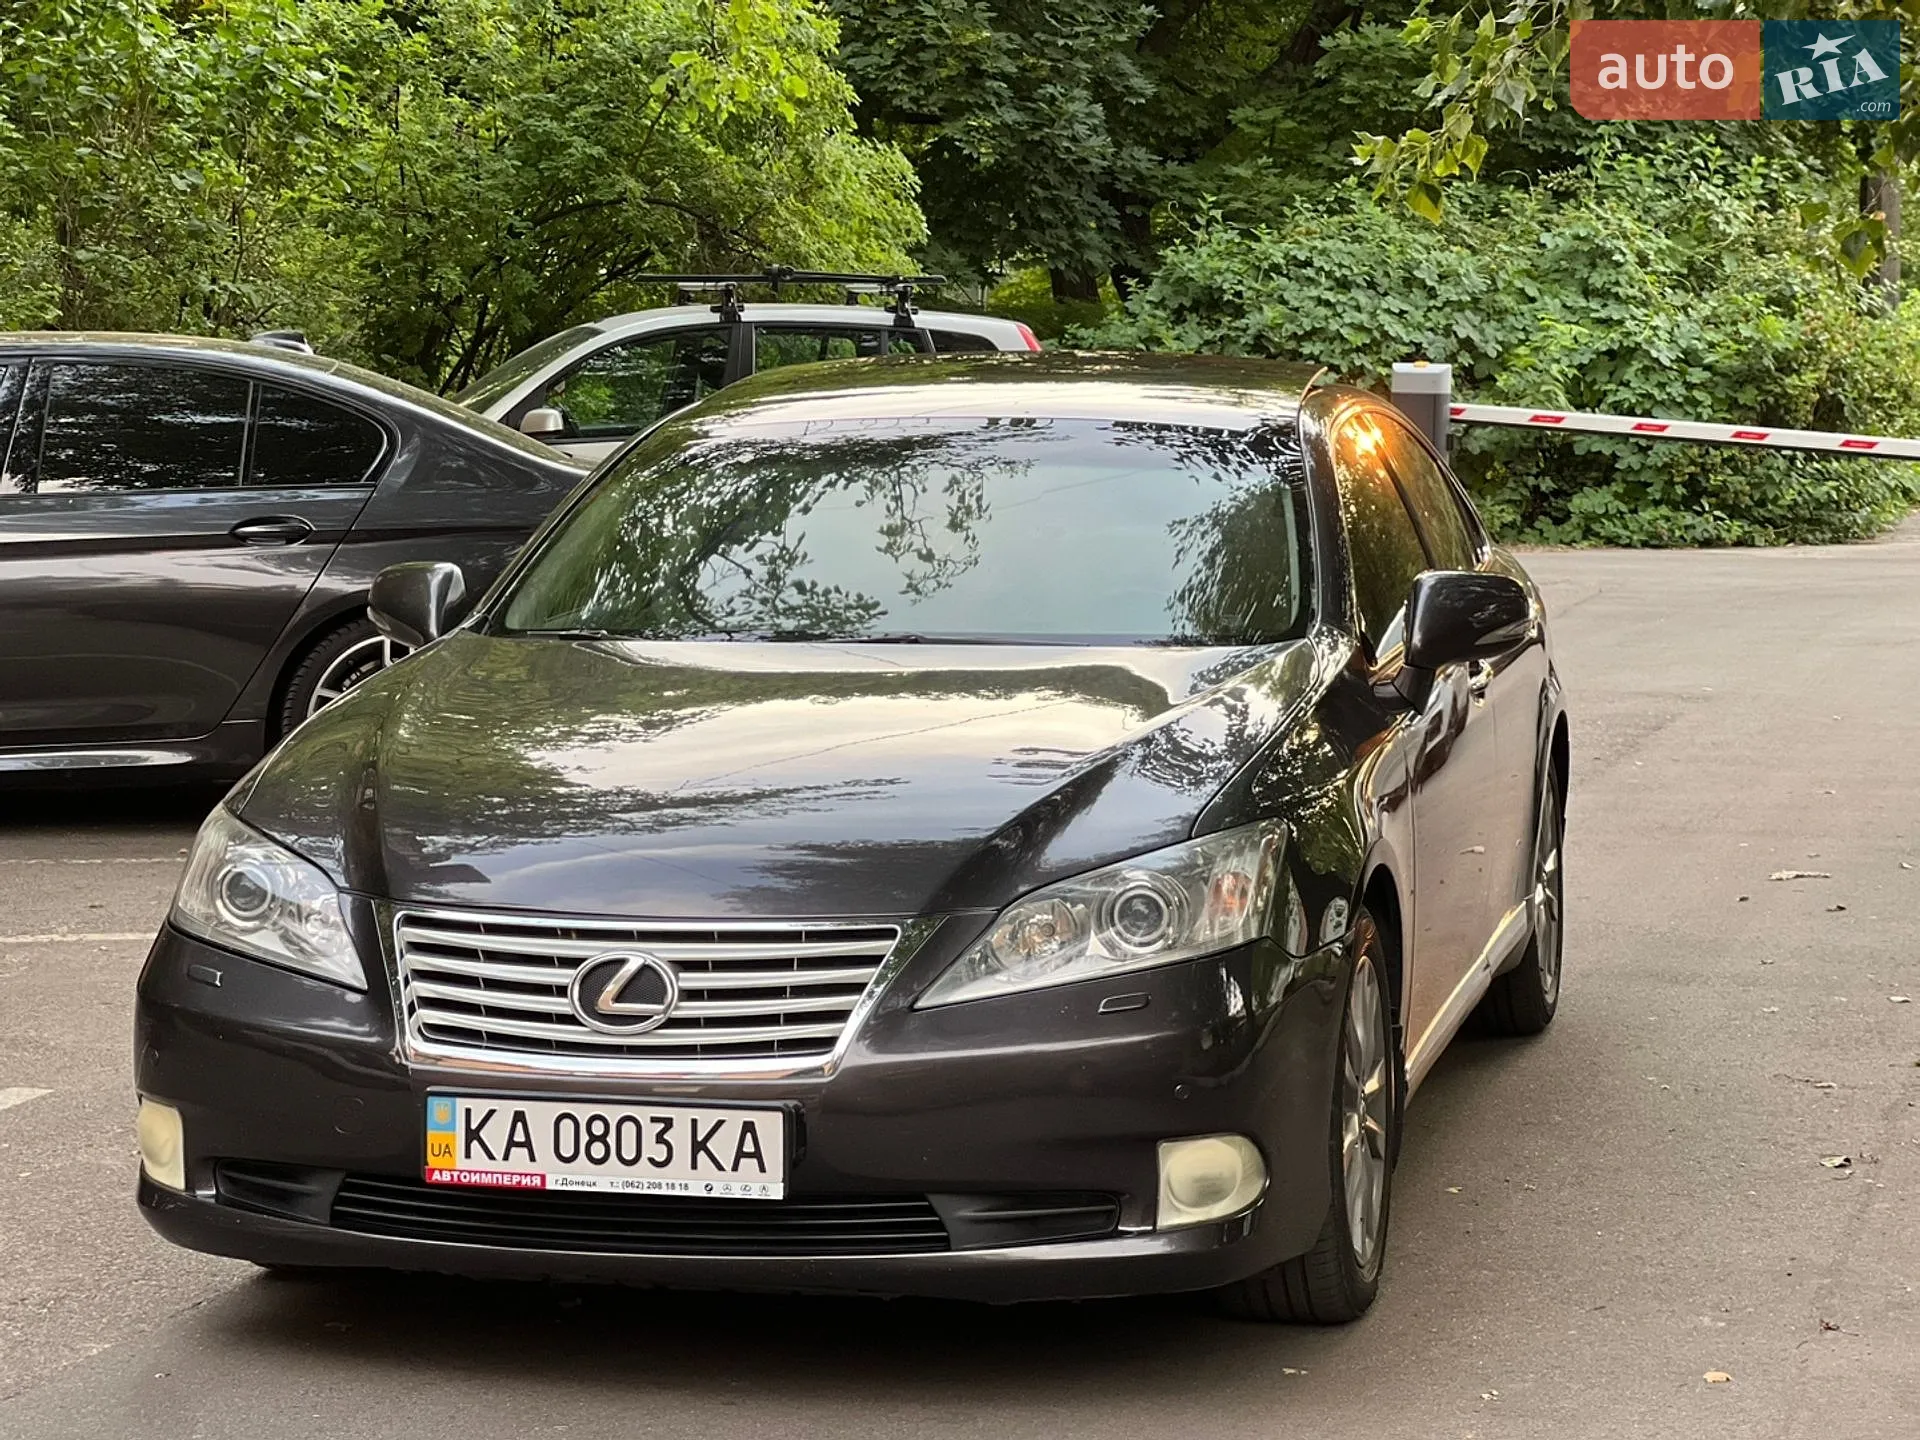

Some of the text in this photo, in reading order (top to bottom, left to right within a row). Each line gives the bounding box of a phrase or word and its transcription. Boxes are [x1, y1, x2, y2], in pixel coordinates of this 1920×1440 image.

[464, 1107, 767, 1173] KA 0803 KA
[430, 1143, 453, 1158] UA
[431, 1169, 541, 1187] АВТОИМПЕРИЯ
[554, 1178, 597, 1189] г.Донецк
[621, 1180, 644, 1191] (062)
[646, 1181, 662, 1191] 208
[666, 1182, 676, 1191] 18
